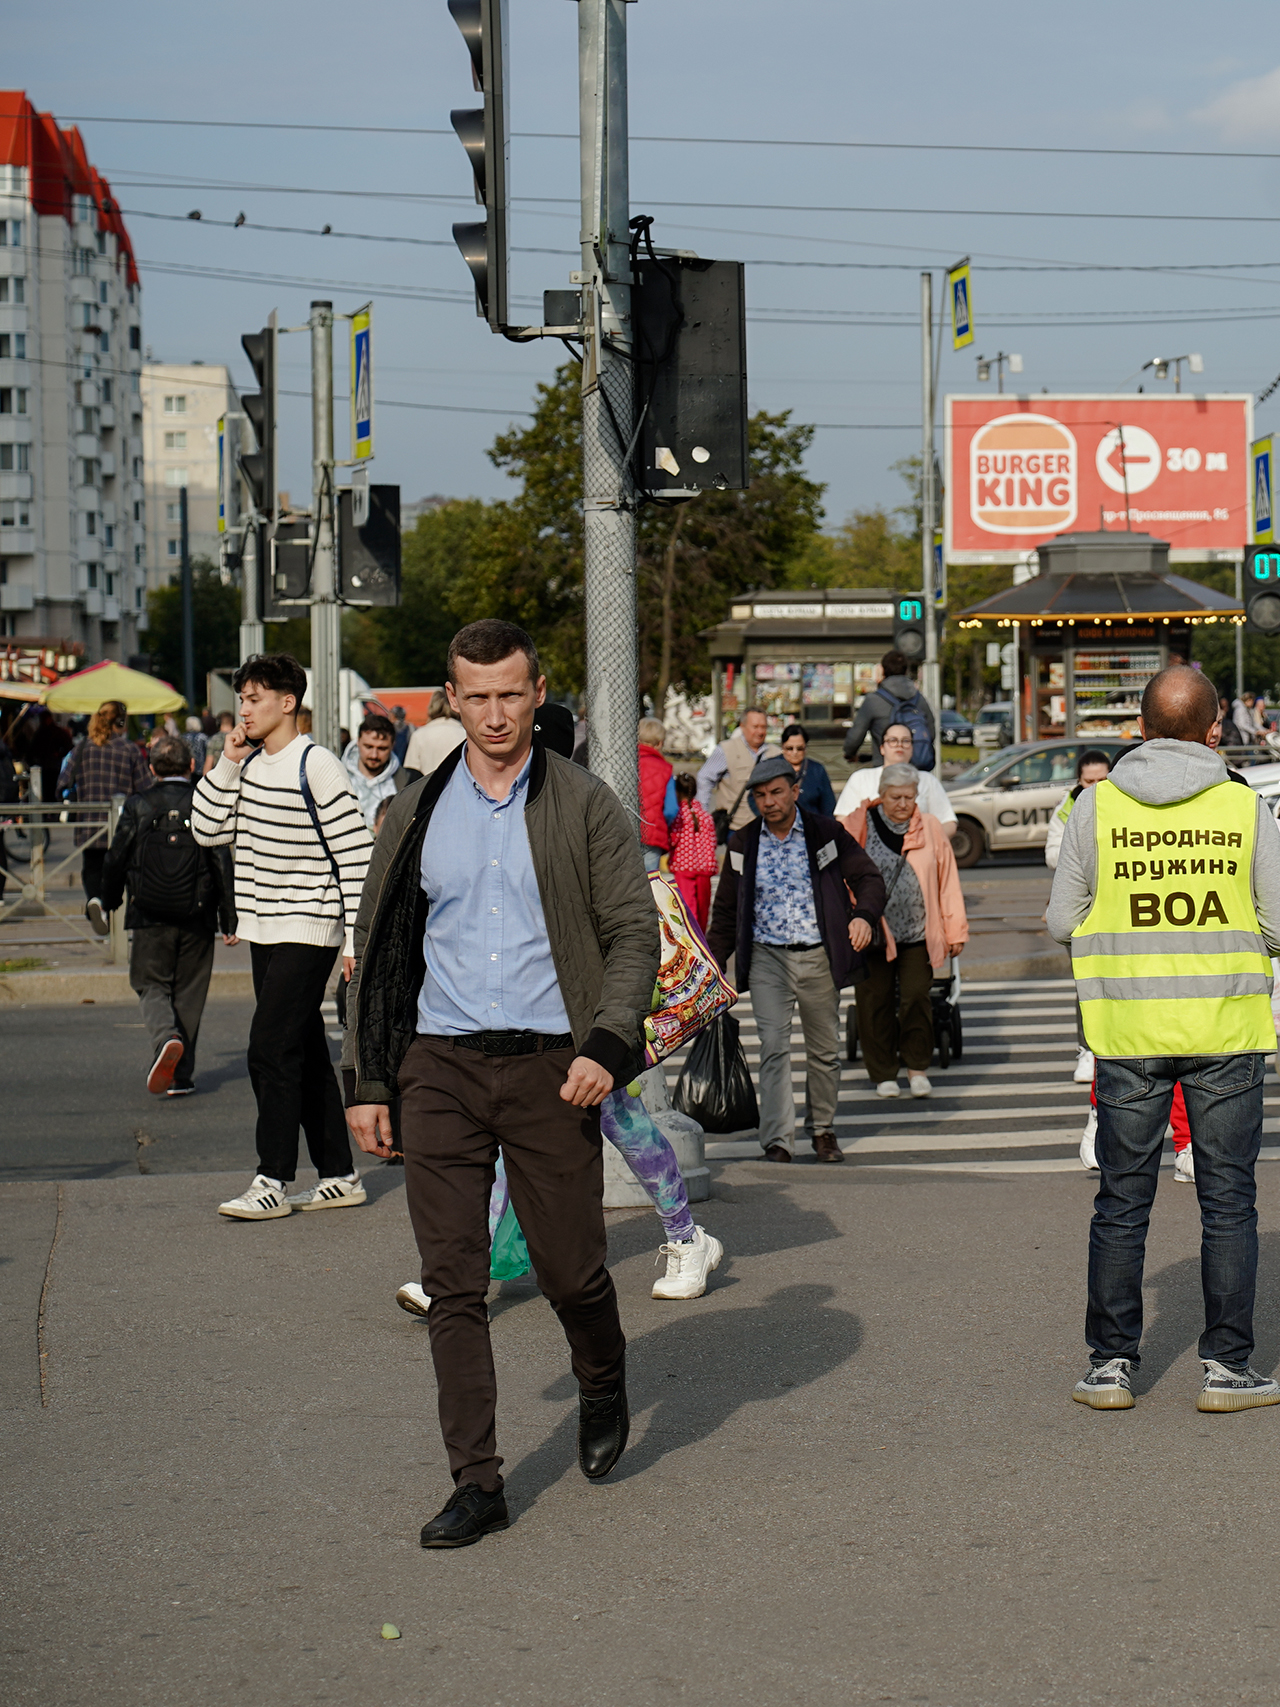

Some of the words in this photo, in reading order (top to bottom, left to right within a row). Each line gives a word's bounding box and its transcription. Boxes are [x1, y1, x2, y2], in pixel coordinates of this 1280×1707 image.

[977, 454, 1070, 474] BURGER
[1166, 447, 1201, 472] 30
[1205, 451, 1228, 472] м
[977, 477, 1070, 507] KING
[900, 601, 922, 621] 07
[1112, 827, 1242, 852] Народная
[1114, 859, 1237, 881] дружина
[1129, 891, 1229, 927] ВОА
